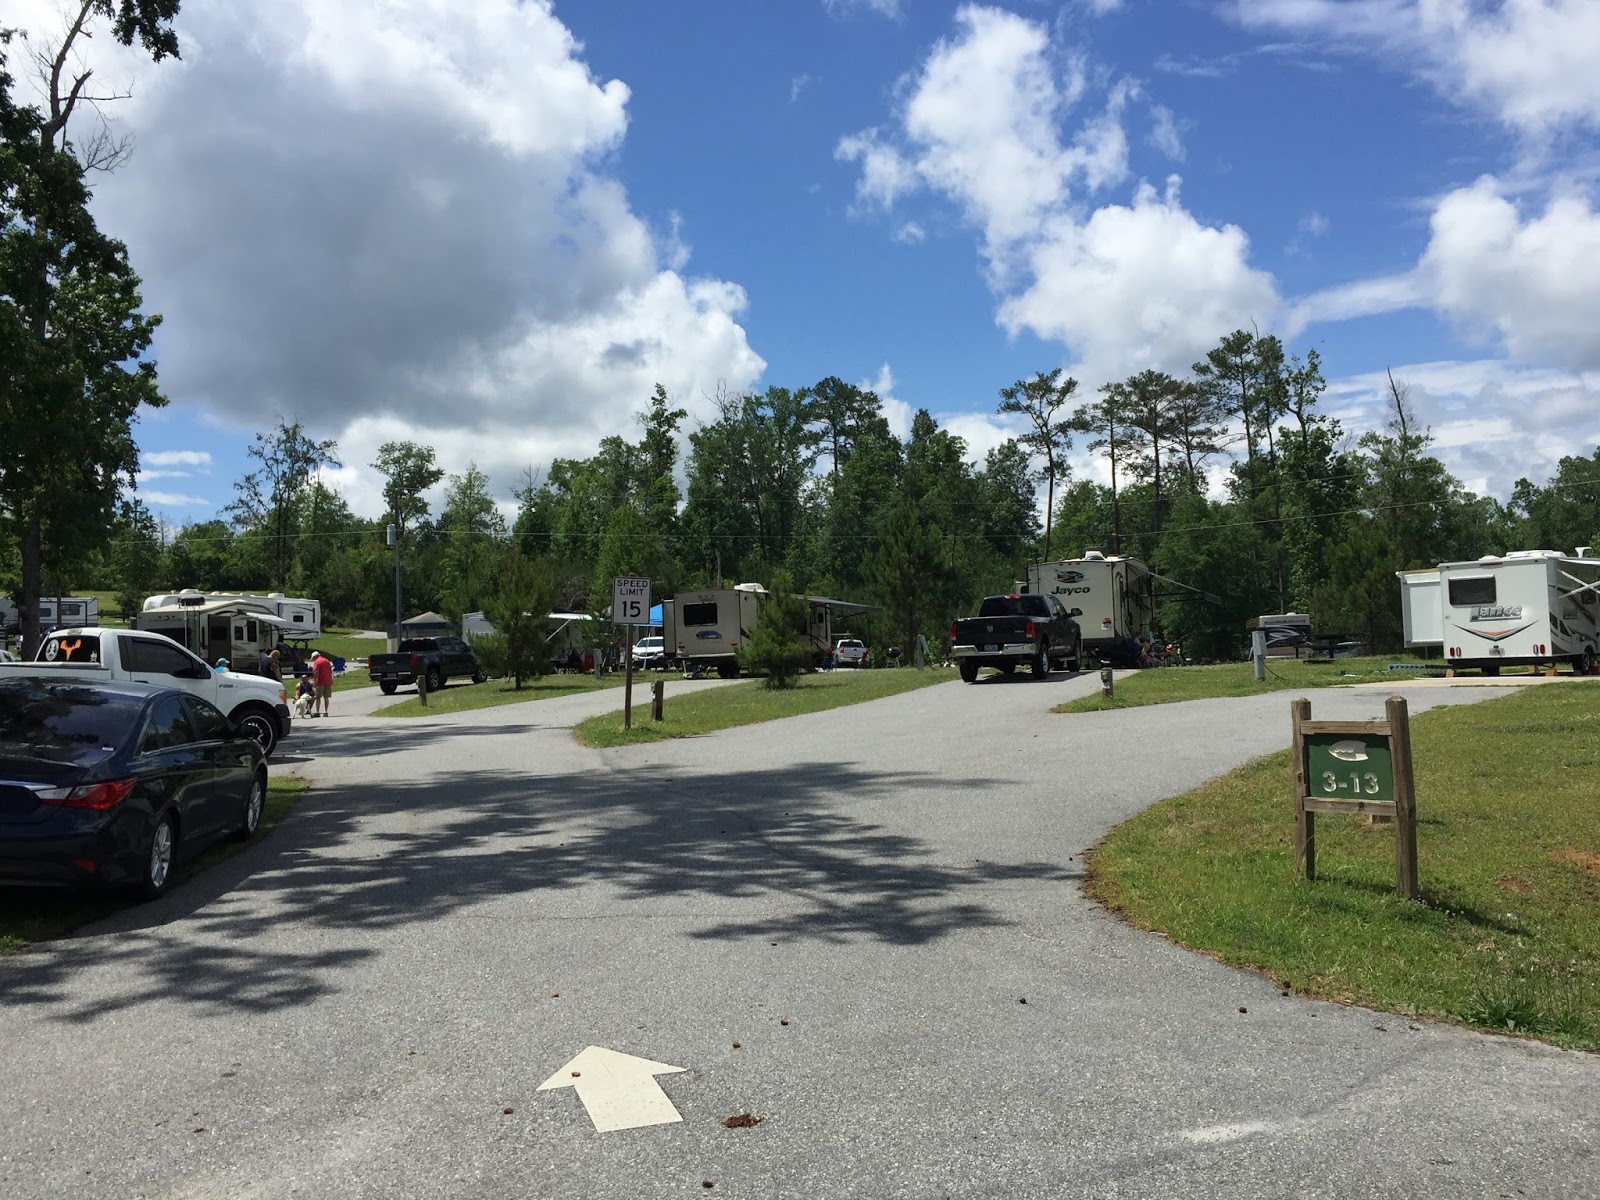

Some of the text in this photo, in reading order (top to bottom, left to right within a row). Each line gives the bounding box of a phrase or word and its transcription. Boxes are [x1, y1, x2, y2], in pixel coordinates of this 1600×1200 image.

[620, 588, 644, 596] LIMIT
[1051, 586, 1091, 596] Jayco
[622, 600, 641, 618] 15
[1470, 605, 1523, 622] Lance
[1322, 770, 1379, 794] 3-13
